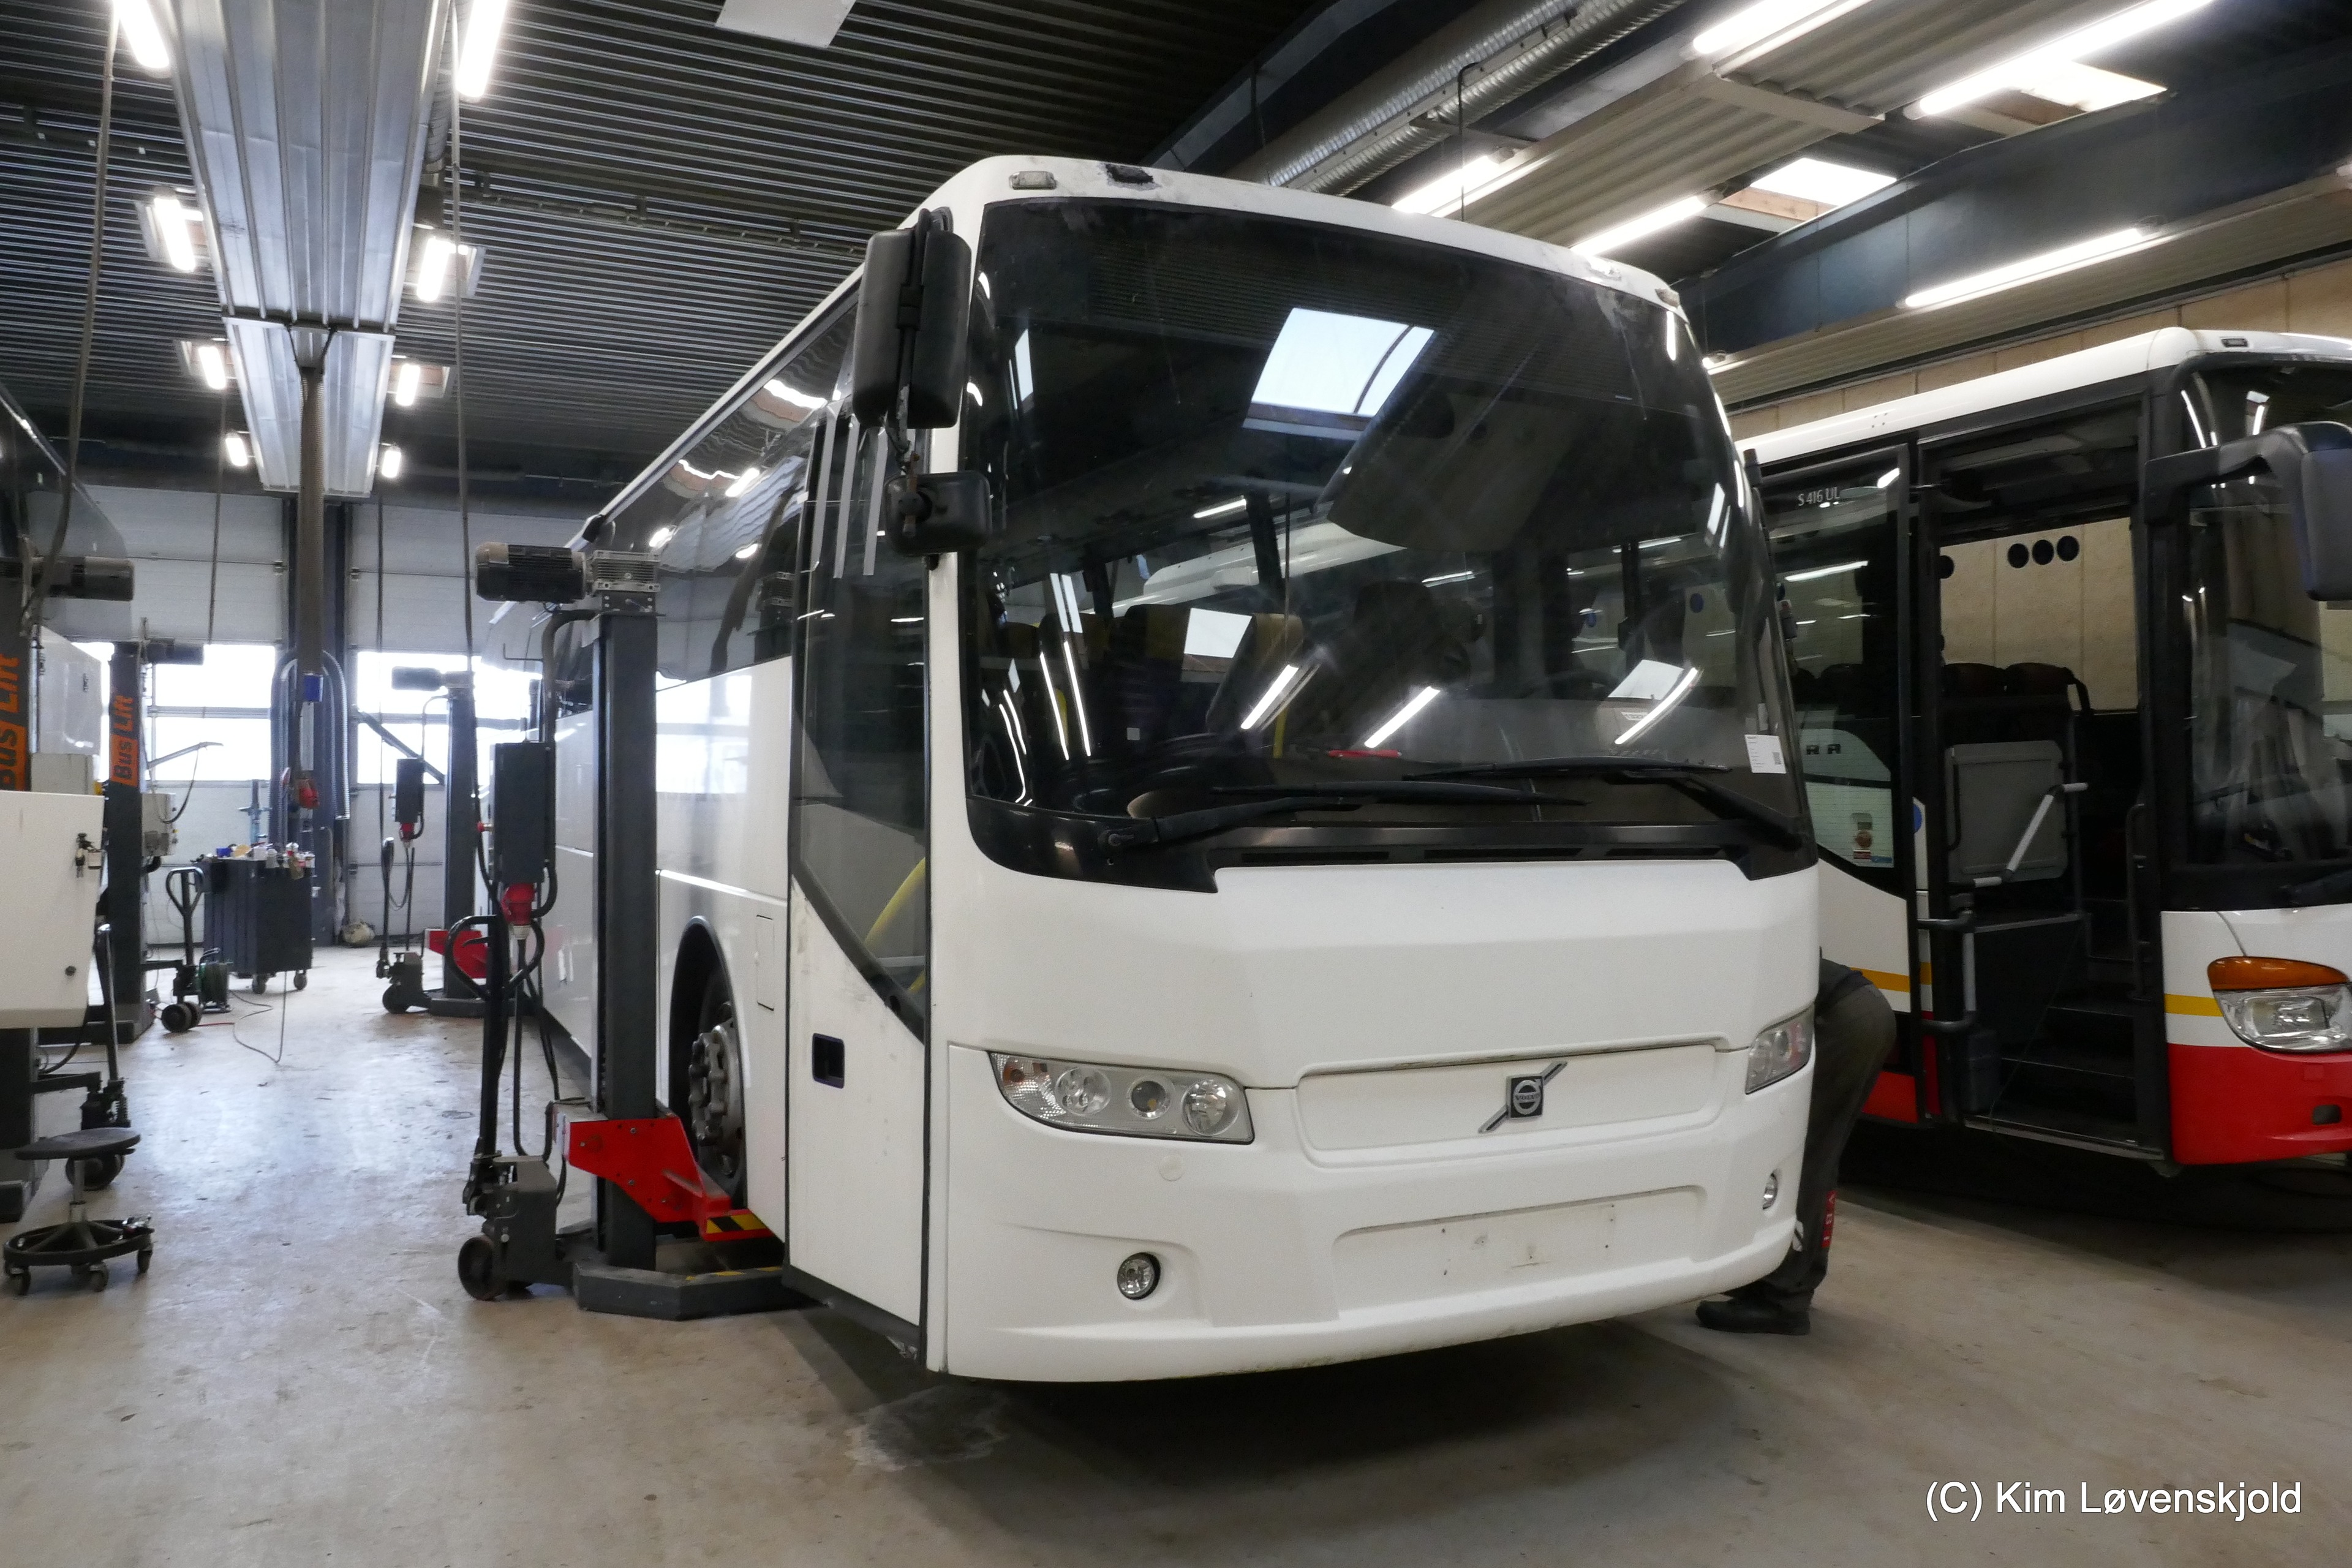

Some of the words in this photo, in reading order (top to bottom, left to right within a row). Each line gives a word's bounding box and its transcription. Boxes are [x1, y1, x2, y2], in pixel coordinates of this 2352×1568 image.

[1798, 493, 1804, 507] S
[1806, 489, 1823, 505] 416
[1825, 486, 1840, 500] UL
[114, 695, 134, 732] Lift
[114, 741, 132, 780] Bus
